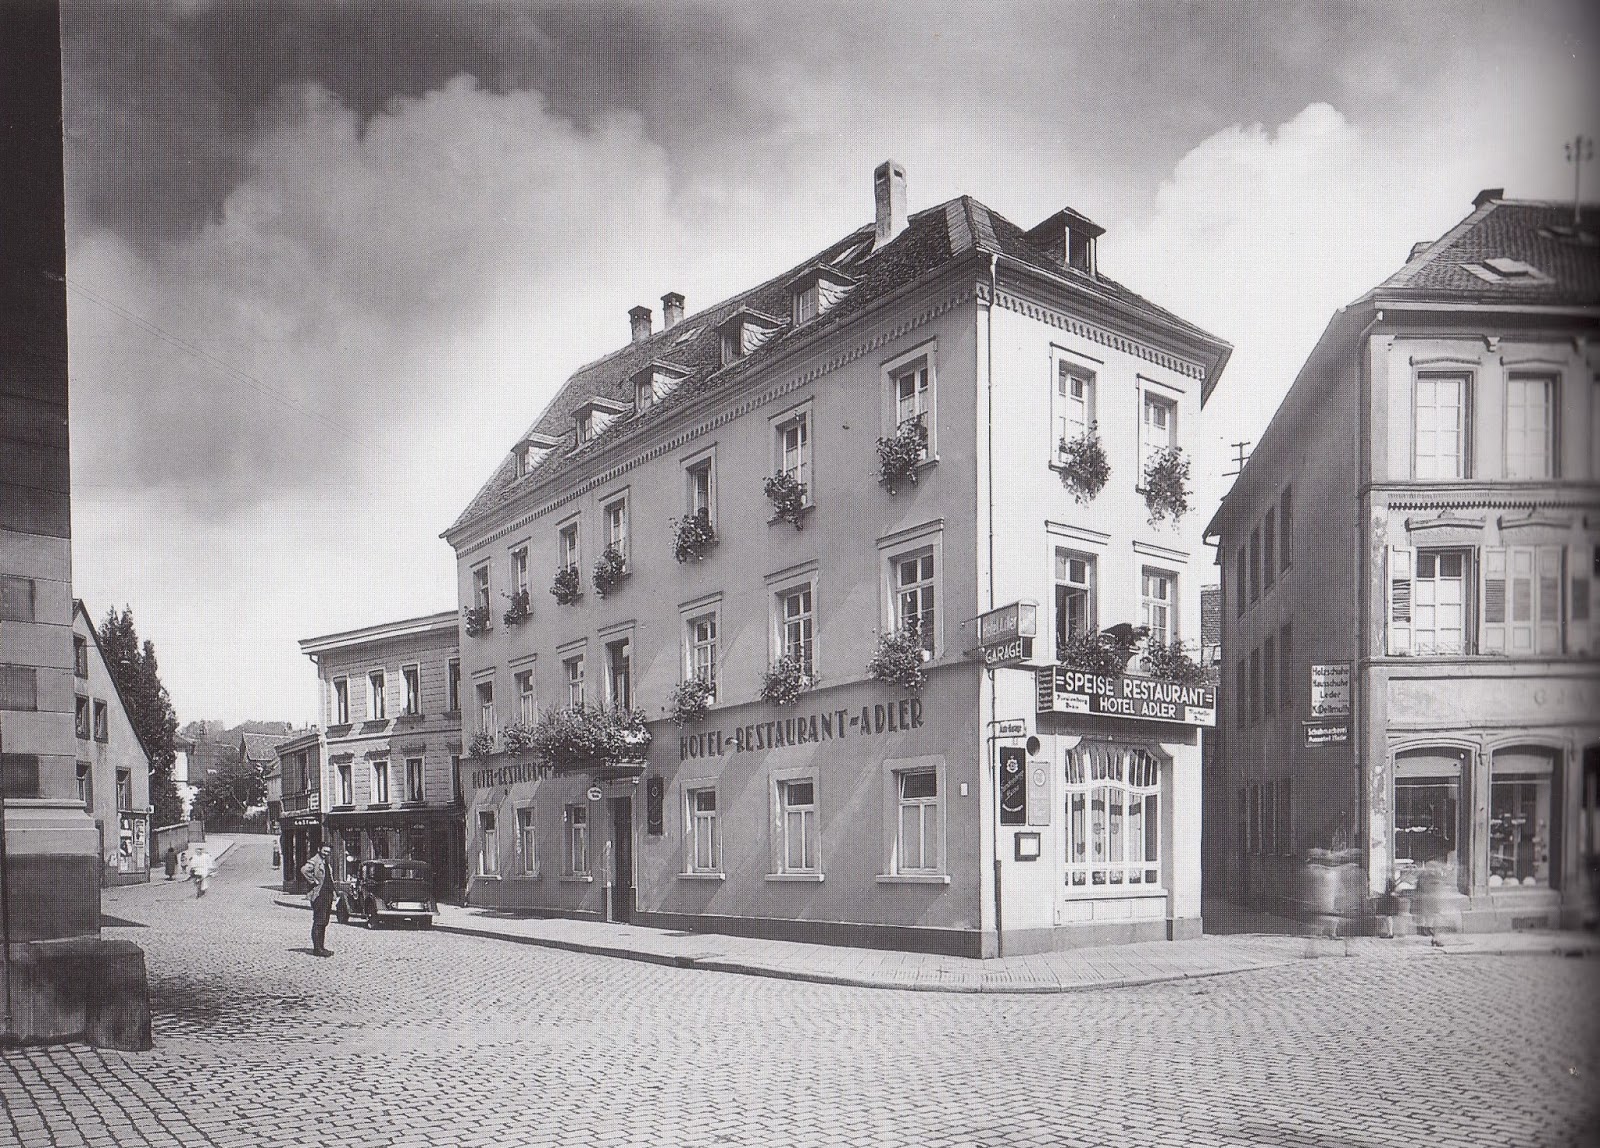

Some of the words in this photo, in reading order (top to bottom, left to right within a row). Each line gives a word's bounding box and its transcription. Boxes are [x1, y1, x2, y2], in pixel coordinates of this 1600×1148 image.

[985, 640, 1022, 664] GARAGE
[1320, 690, 1341, 699] Leder
[1100, 696, 1135, 714] HOTEL
[1141, 702, 1176, 719] ADLER
